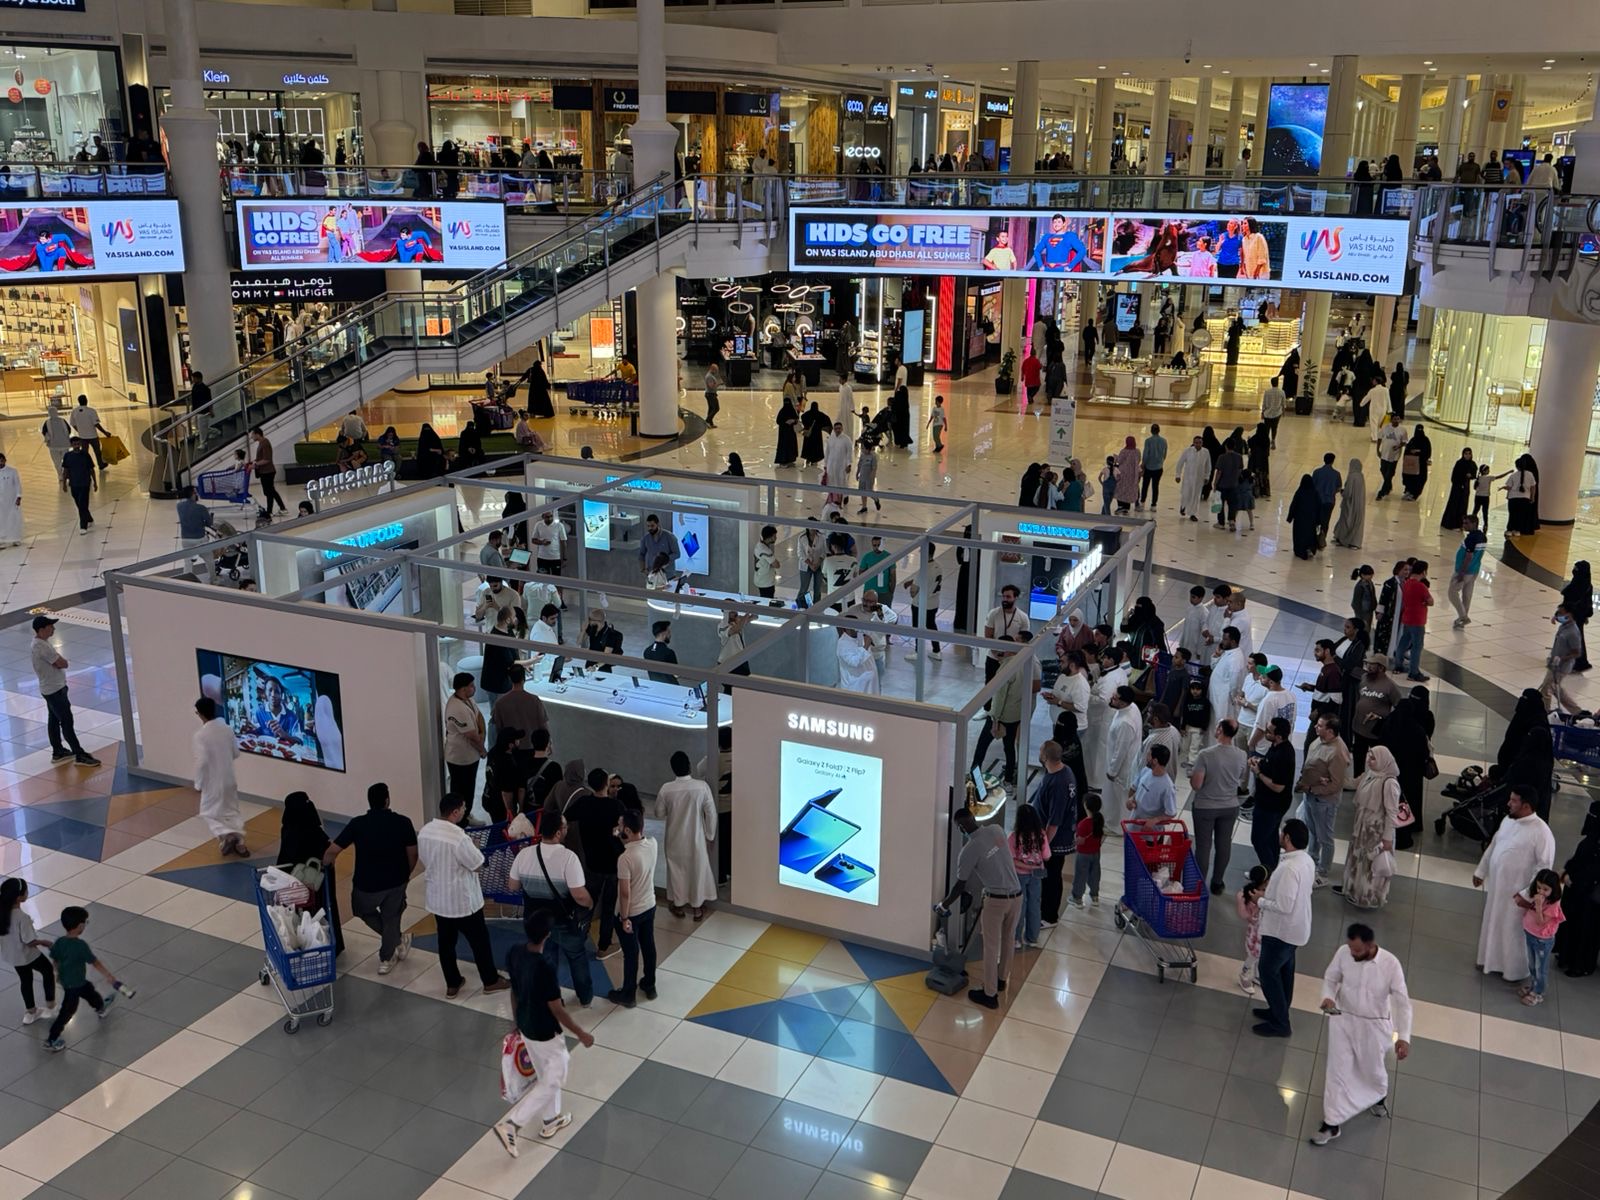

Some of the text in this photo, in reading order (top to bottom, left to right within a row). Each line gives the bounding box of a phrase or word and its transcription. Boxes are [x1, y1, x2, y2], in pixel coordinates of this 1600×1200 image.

[203, 70, 230, 83] Klein
[846, 146, 881, 158] ecco
[252, 211, 318, 232] KIDS
[254, 232, 319, 245] GO FREE
[807, 222, 972, 248] KIDS GO FREE
[1349, 243, 1394, 252] YAS ISLAND
[105, 250, 174, 258] YASISLAND.COM
[805, 248, 970, 260] ON YAS ISLAND ABU DHABI ALL SUMMER
[1298, 270, 1390, 283] YASISLAND.COM
[231, 288, 335, 299] OMMY HILFIGER
[1018, 522, 1090, 540] ULTRA UNFOLDS
[787, 712, 875, 743] SAMSUNG
[796, 757, 820, 768] Galaxy
[815, 769, 834, 777] Galaxy
